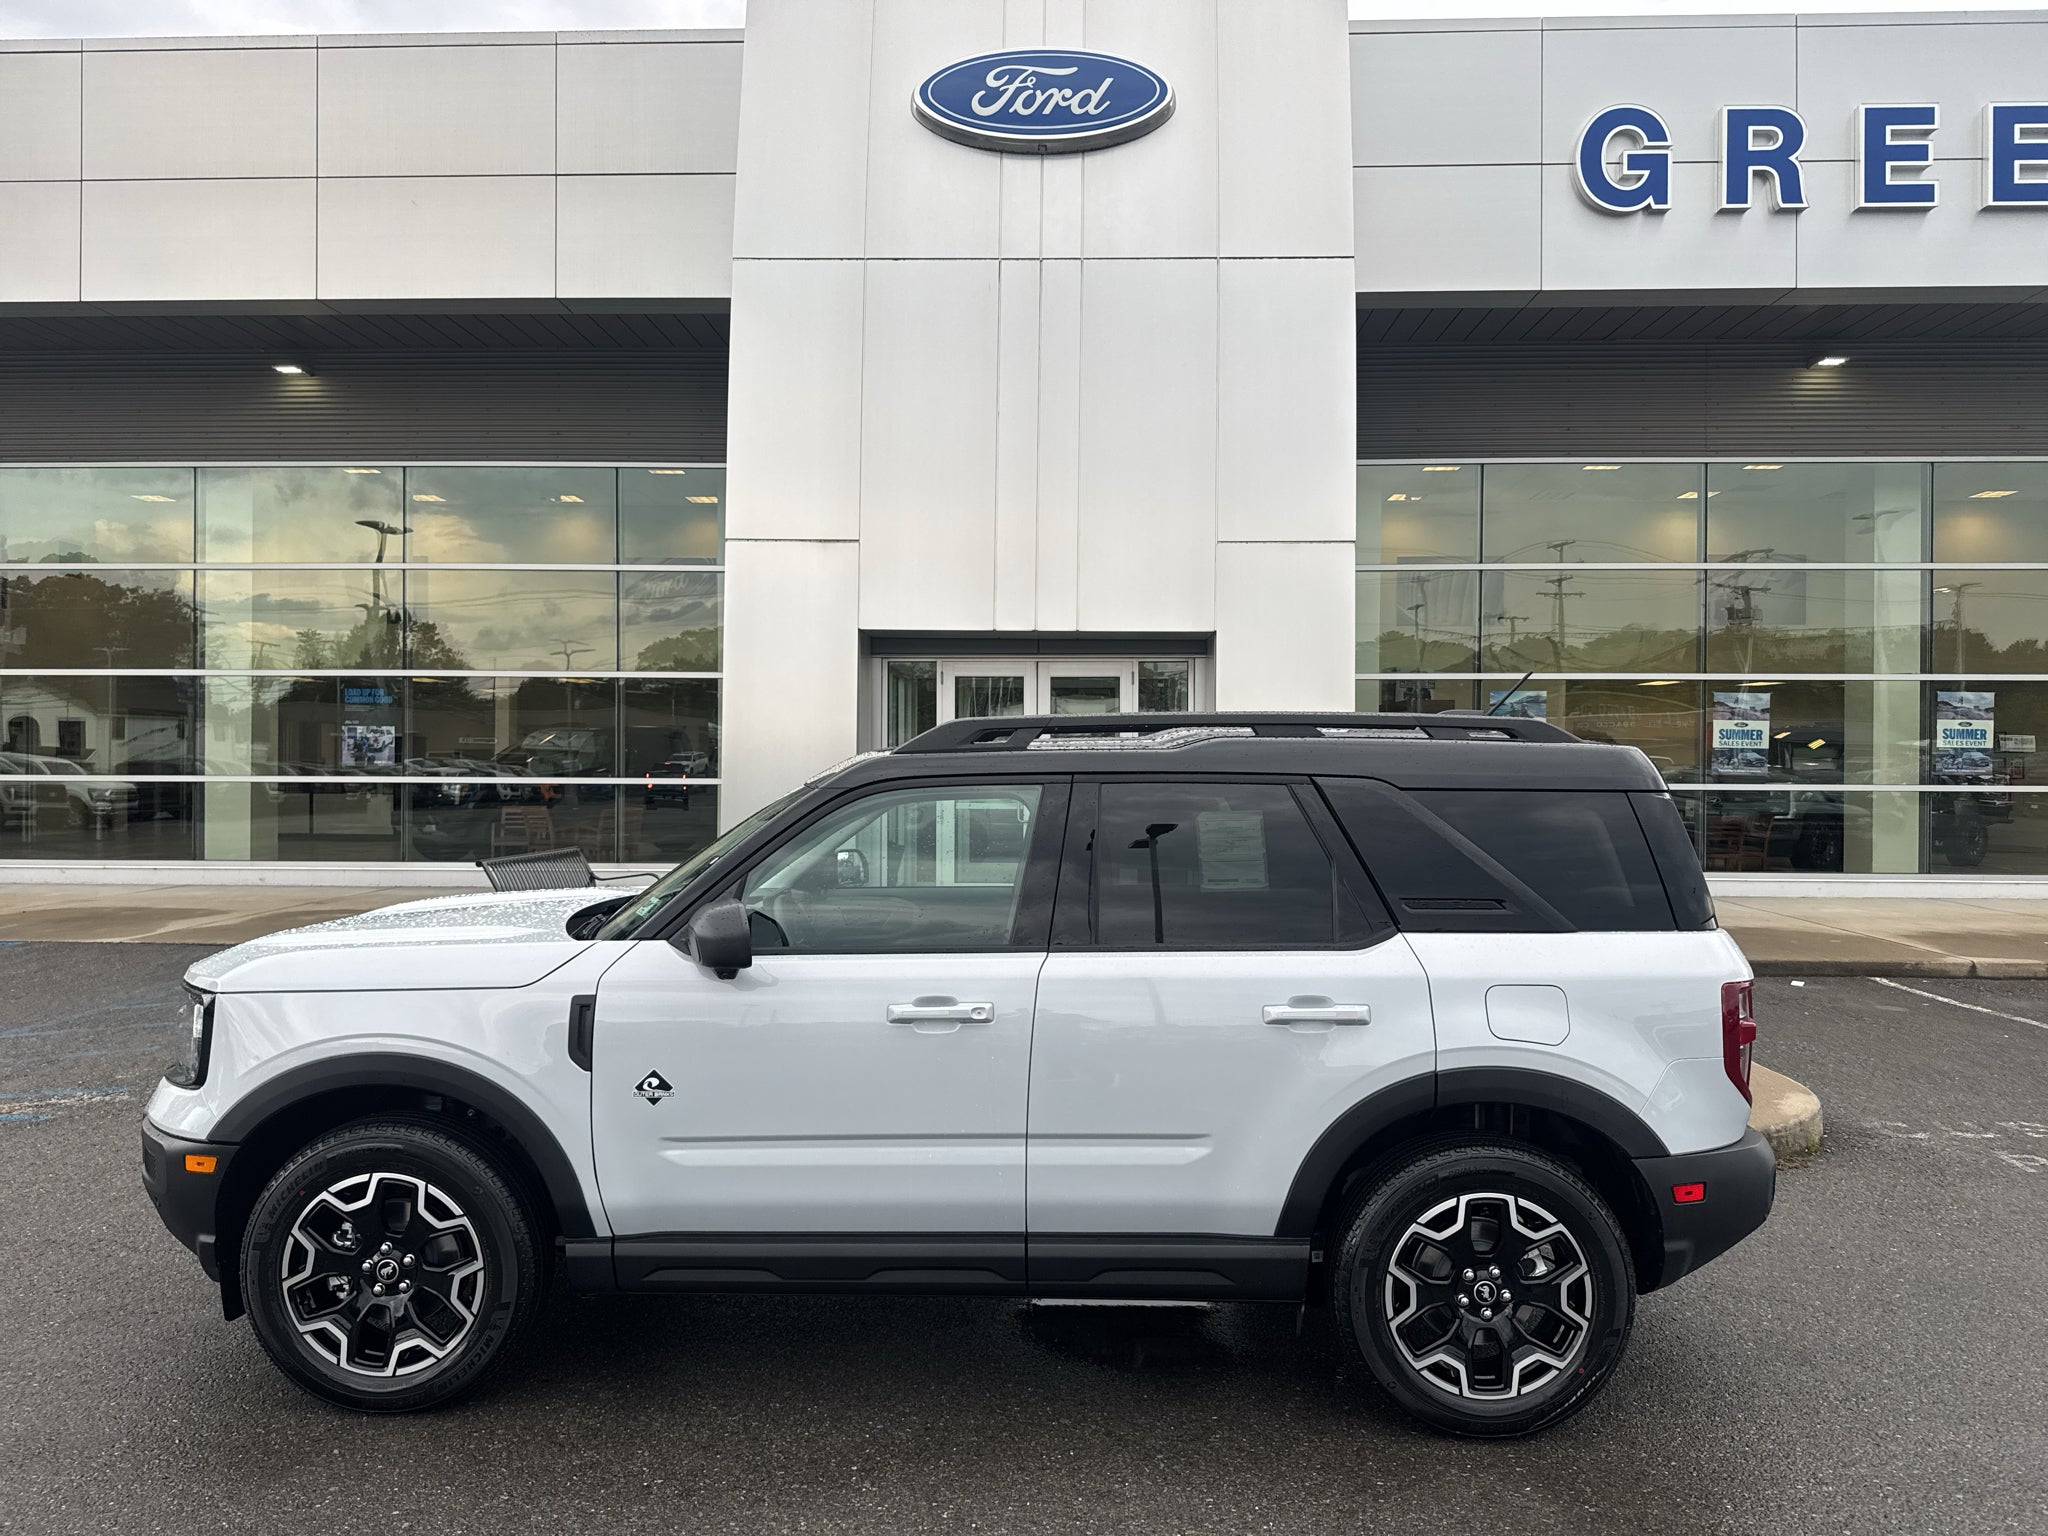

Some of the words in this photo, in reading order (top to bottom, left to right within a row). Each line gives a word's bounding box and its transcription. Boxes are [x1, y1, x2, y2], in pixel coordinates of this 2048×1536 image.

[971, 65, 1114, 116] Ford
[1575, 102, 2048, 213] GREE
[1719, 729, 1763, 741] SUMMER
[1942, 728, 1987, 740] SUMMER
[269, 1161, 324, 1217] MICHELIN
